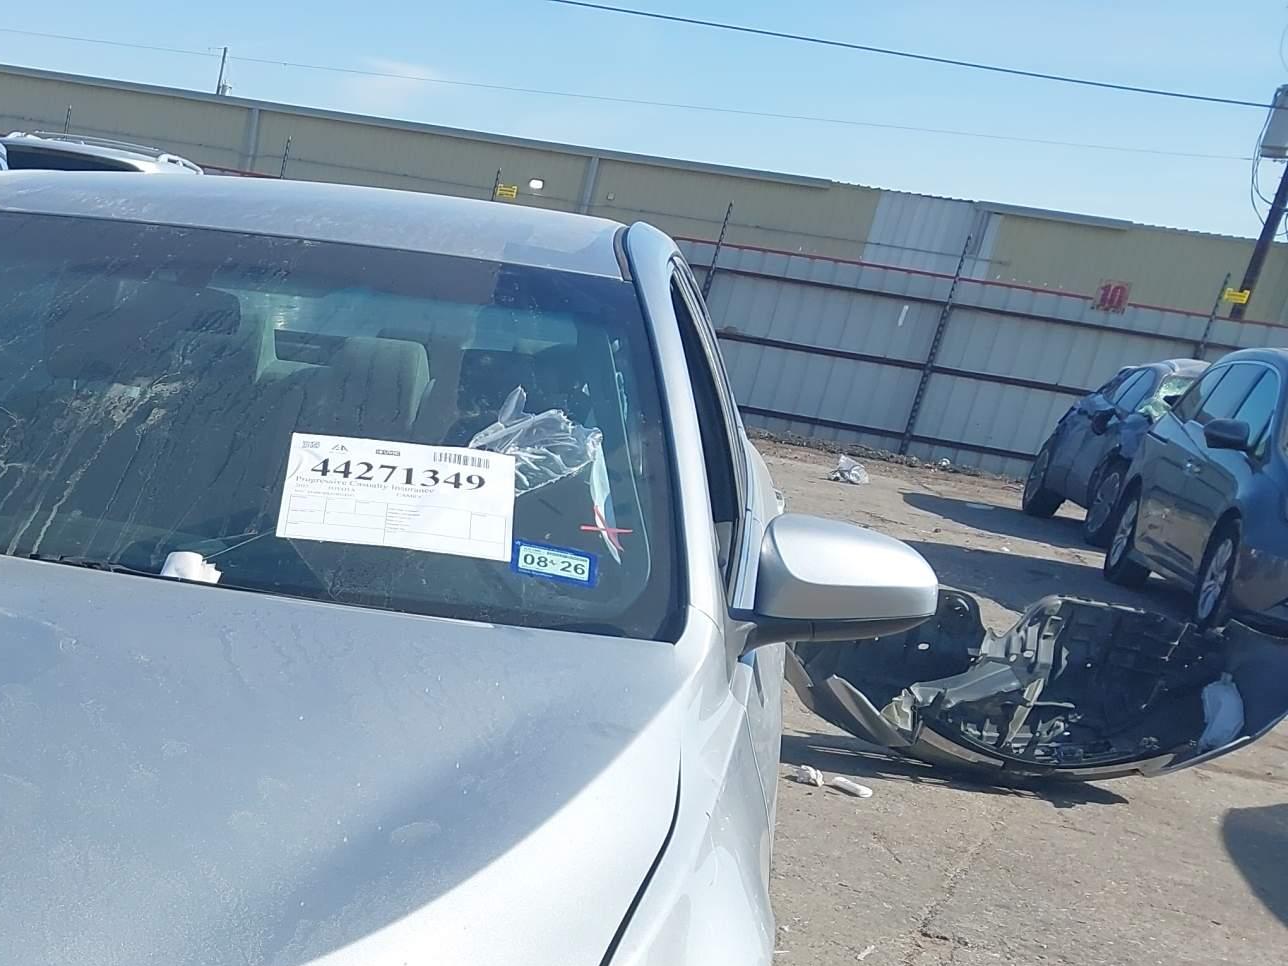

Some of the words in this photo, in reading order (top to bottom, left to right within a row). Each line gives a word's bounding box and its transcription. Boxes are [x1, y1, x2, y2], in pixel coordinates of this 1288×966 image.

[310, 457, 486, 491] 44271349
[523, 553, 549, 568] 08
[559, 560, 586, 575] 26
